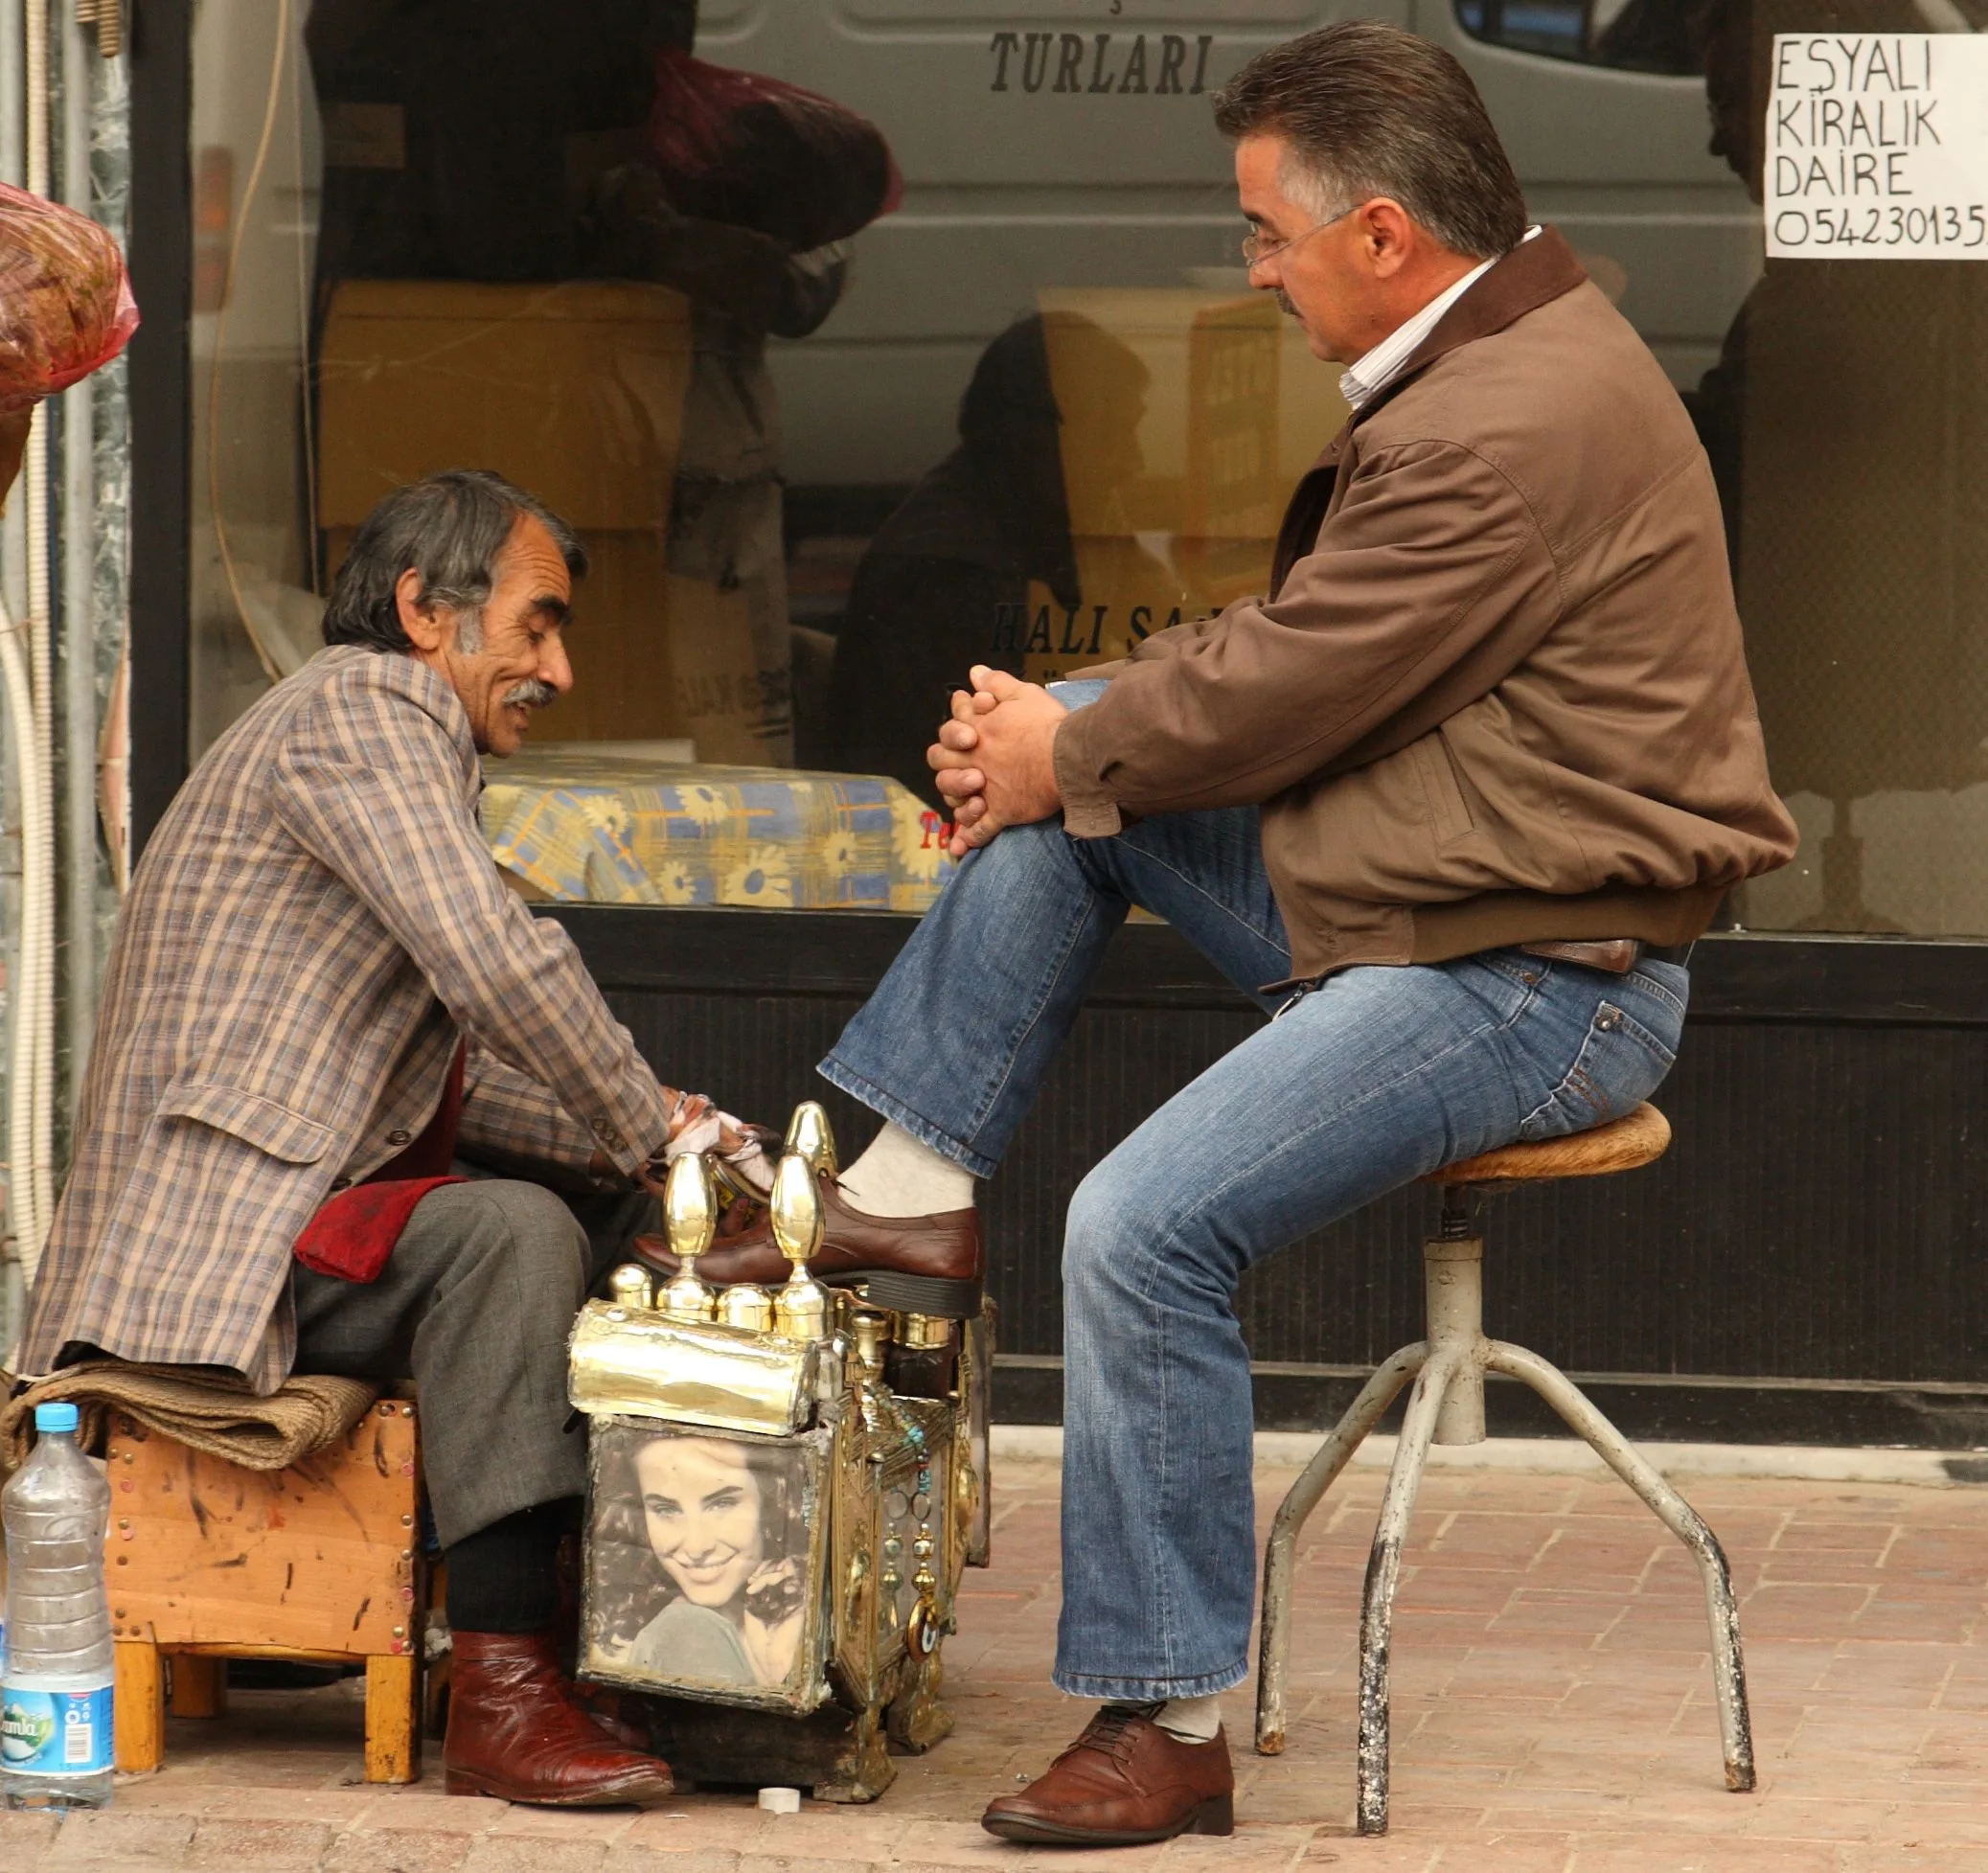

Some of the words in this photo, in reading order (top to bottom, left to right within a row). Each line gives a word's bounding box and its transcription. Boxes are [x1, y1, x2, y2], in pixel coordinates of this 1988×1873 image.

[990, 32, 1213, 94] TURLARI
[1776, 94, 1941, 147] KİRALIK
[1776, 149, 1912, 196] DAİRE
[990, 604, 1108, 654] HALI
